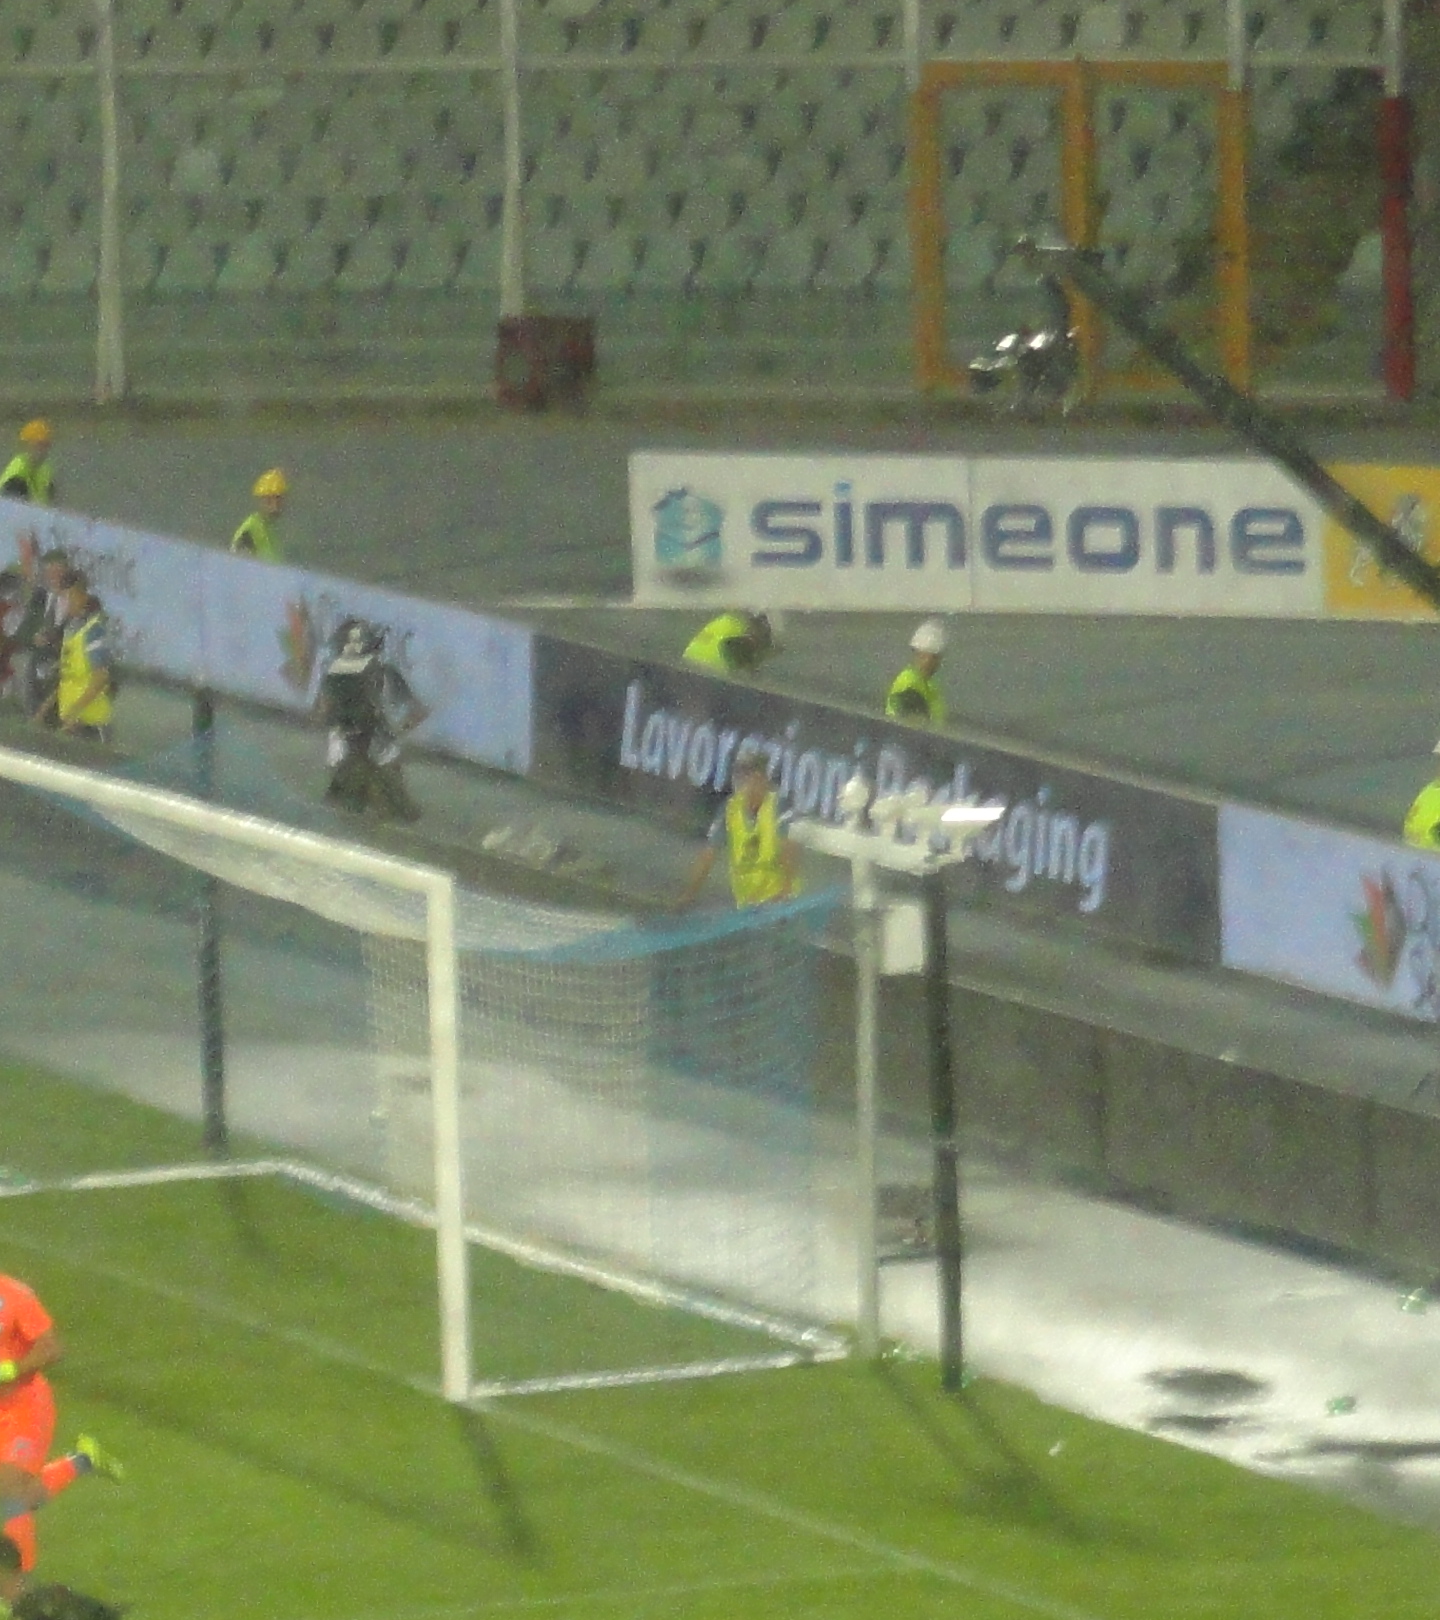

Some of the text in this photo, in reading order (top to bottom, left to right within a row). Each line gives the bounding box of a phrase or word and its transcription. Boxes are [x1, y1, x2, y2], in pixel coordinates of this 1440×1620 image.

[750, 480, 1306, 574] simeone
[620, 679, 1110, 912] Lavorion Paging
